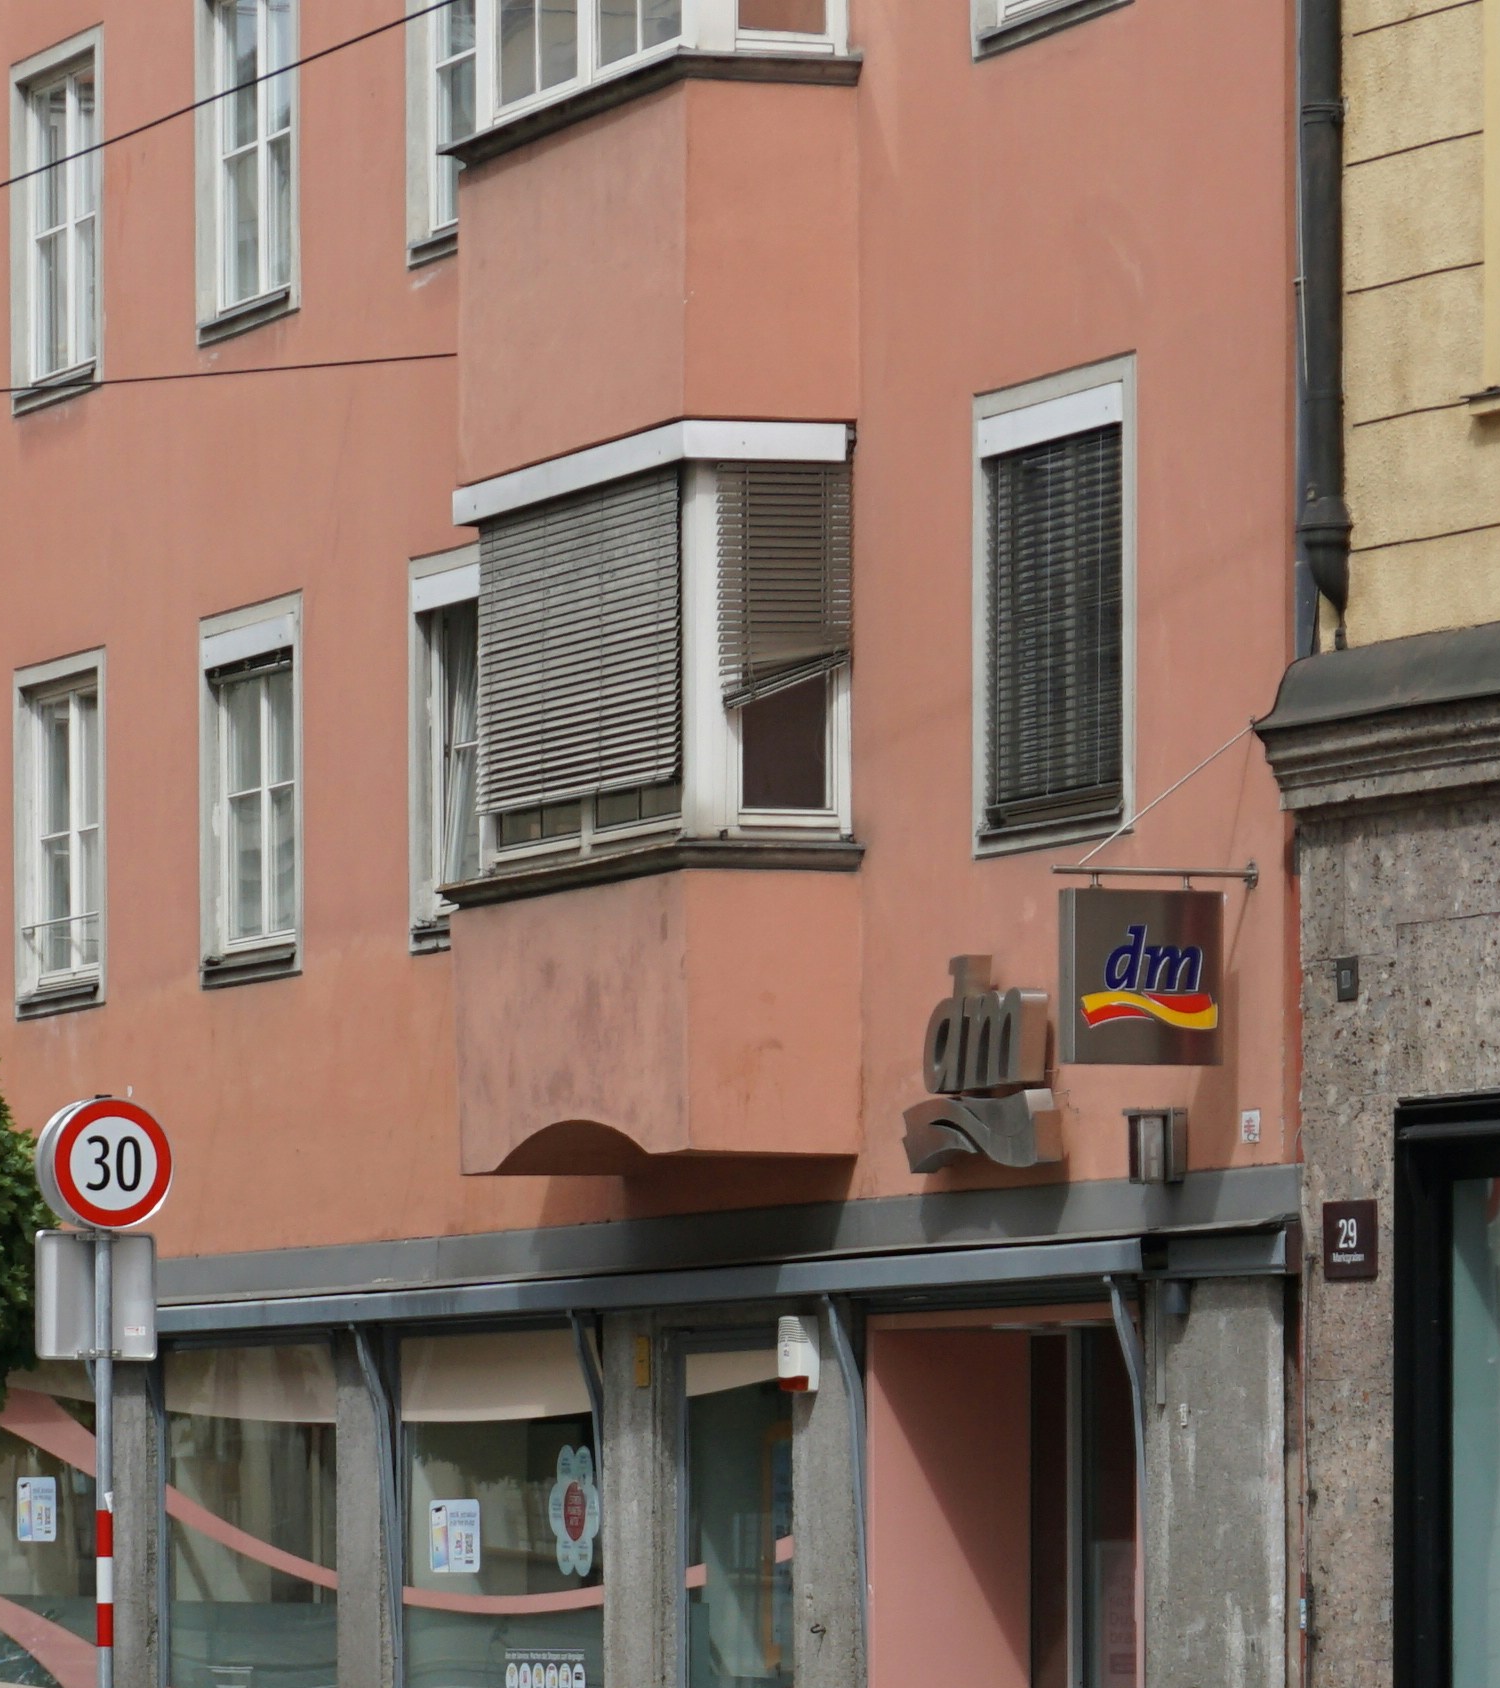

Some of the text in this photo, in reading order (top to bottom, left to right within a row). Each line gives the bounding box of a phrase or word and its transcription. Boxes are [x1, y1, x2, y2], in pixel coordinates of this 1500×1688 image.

[1104, 924, 1203, 992] dm
[923, 954, 1050, 1095] dm
[85, 1135, 142, 1192] 30
[1338, 1218, 1358, 1249] 29
